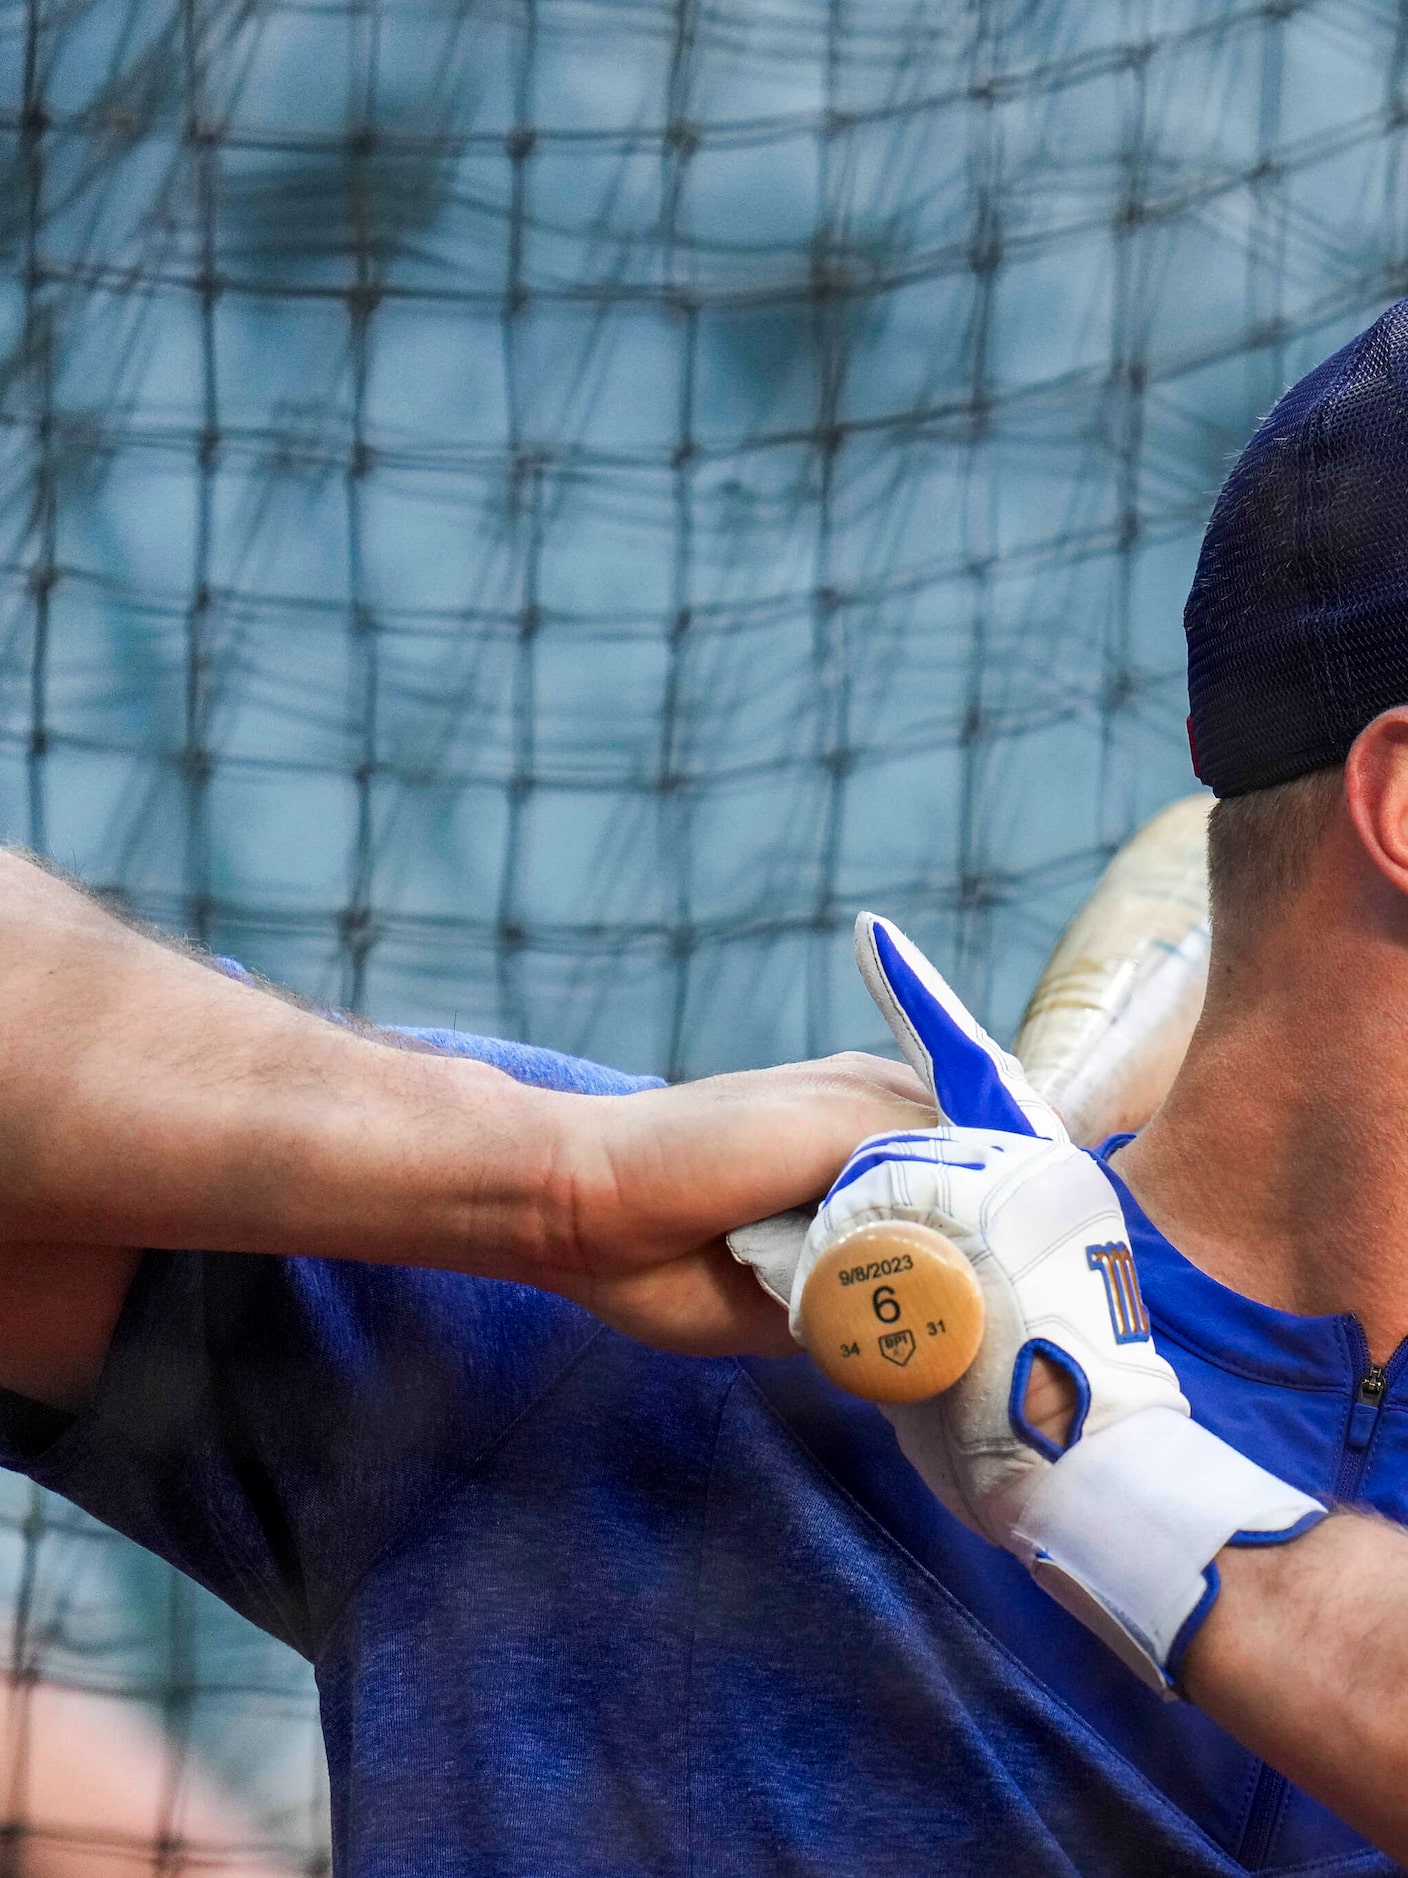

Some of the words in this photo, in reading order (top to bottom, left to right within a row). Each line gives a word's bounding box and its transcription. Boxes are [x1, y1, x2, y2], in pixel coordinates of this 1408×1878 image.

[838, 1254, 913, 1286] 9/8/2023
[872, 1286, 901, 1323] 6
[926, 1319, 946, 1337] 31
[840, 1342, 860, 1358] 34
